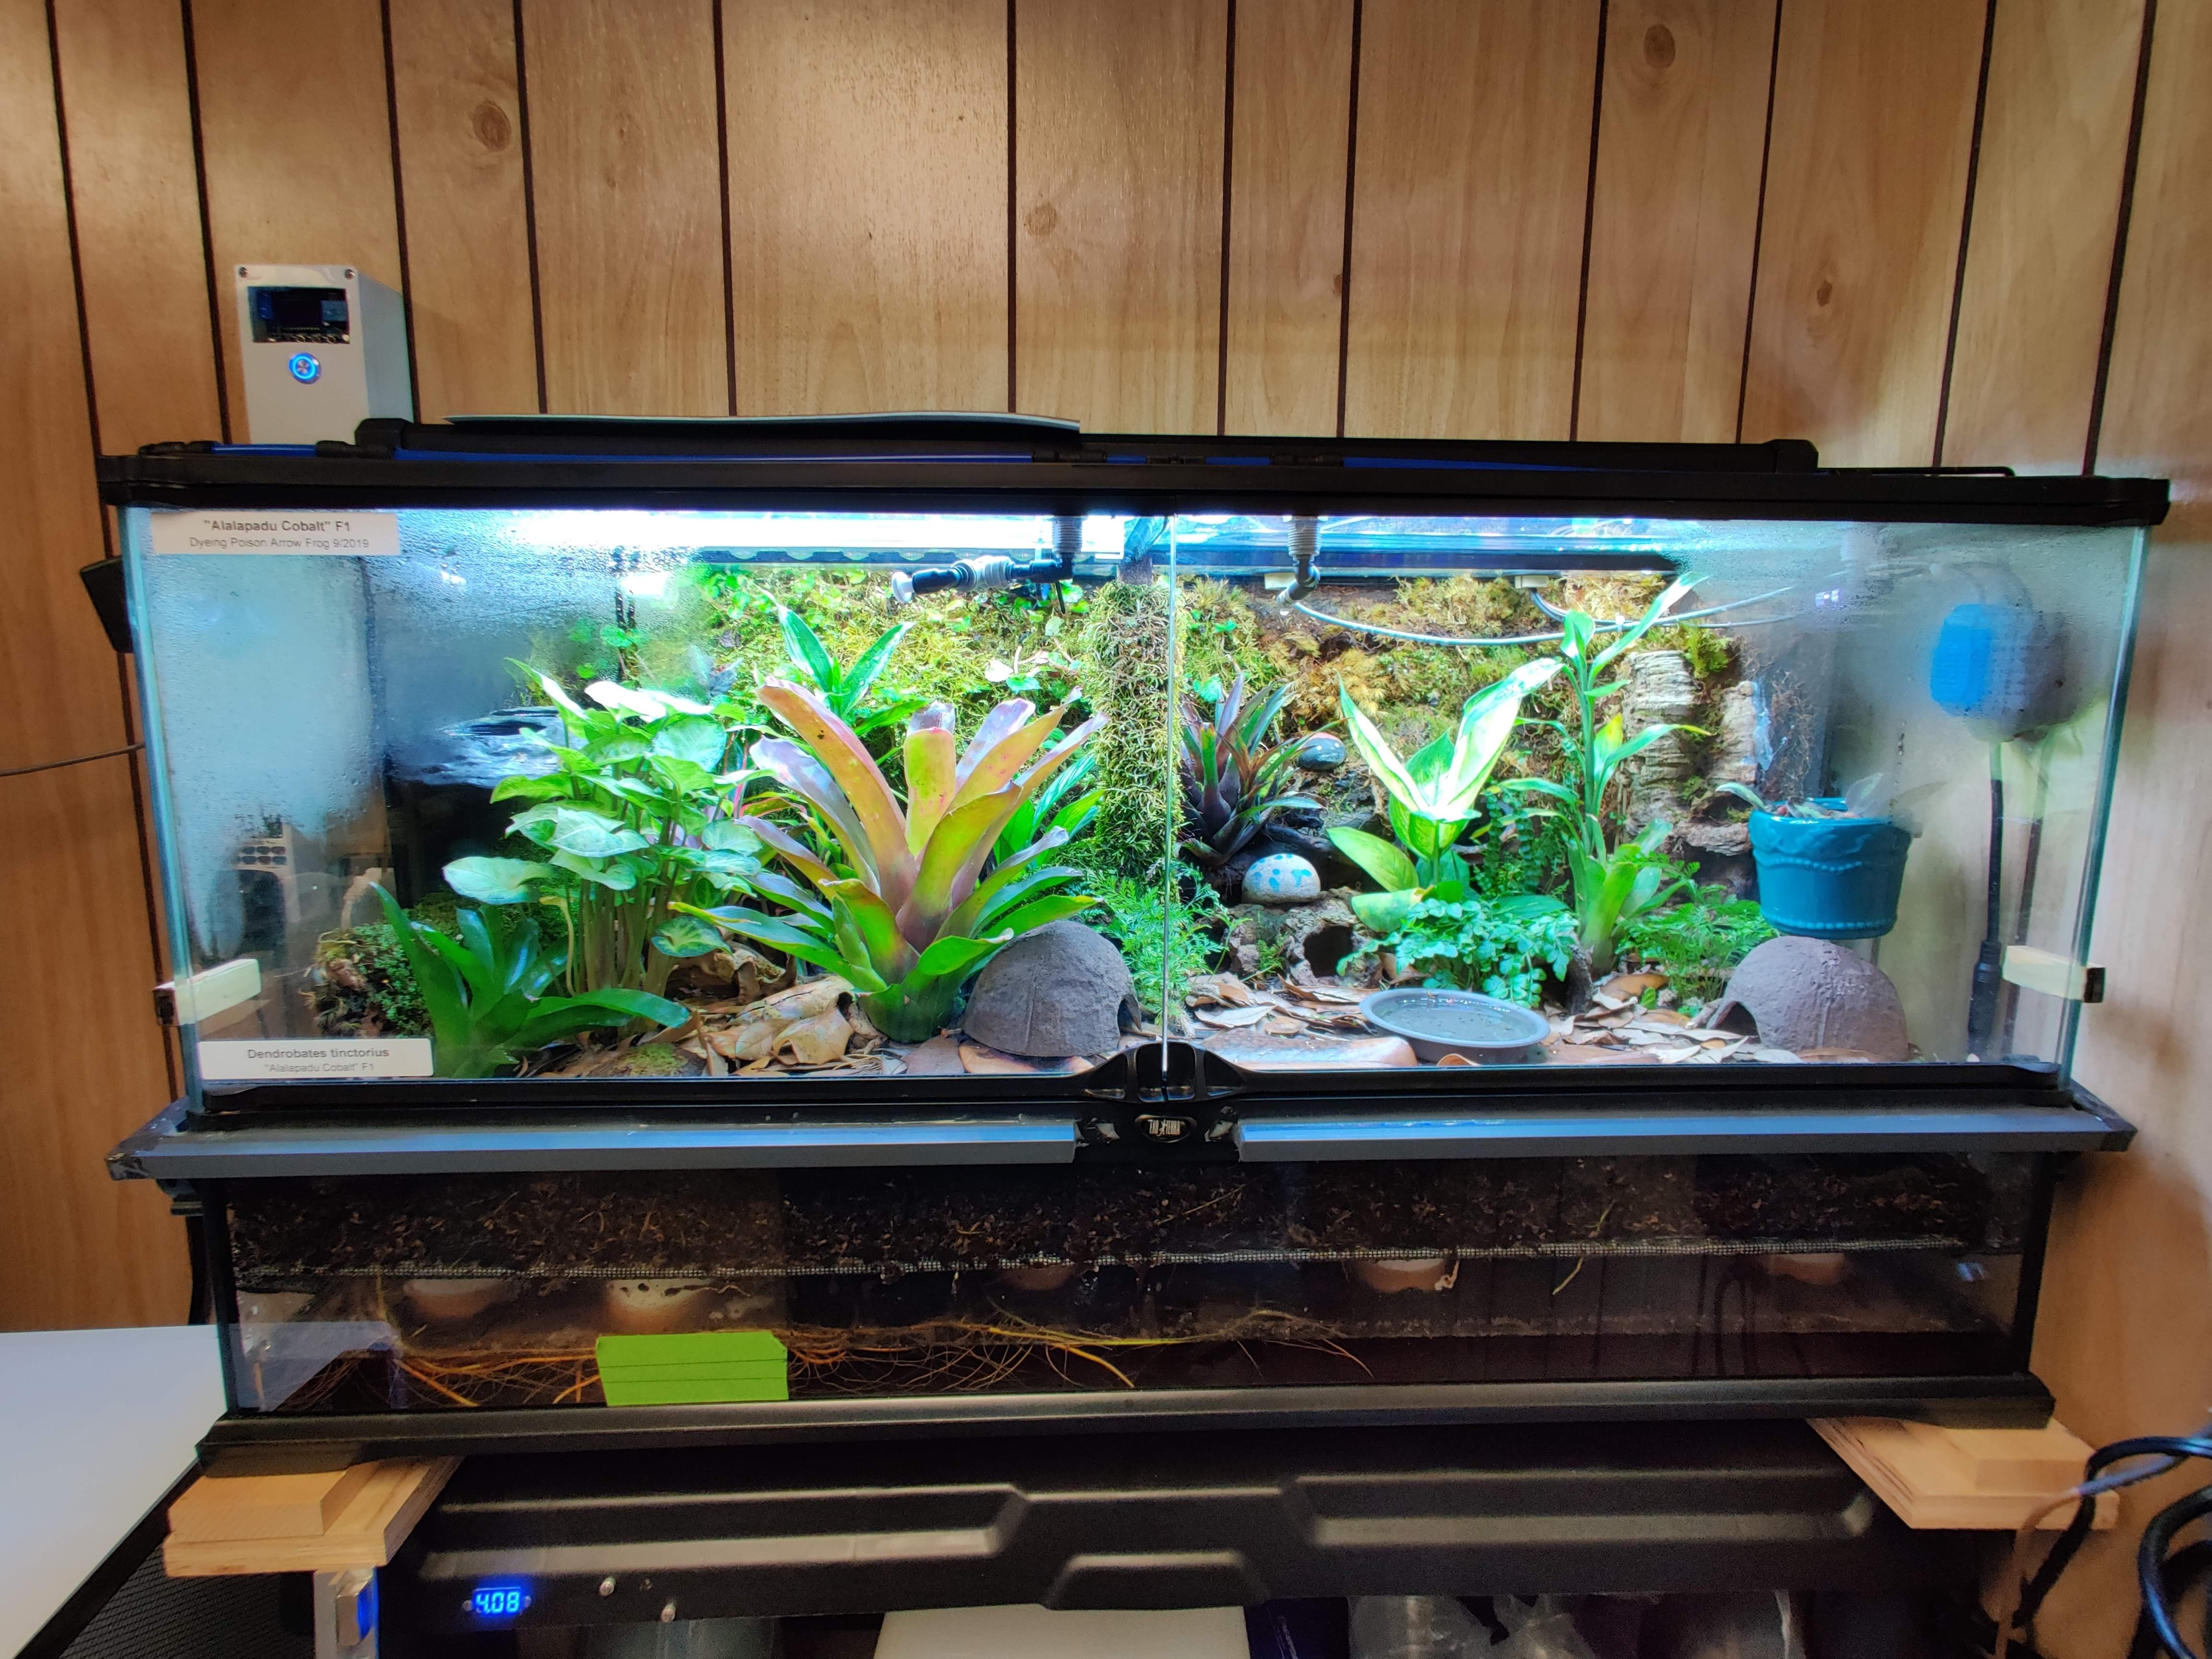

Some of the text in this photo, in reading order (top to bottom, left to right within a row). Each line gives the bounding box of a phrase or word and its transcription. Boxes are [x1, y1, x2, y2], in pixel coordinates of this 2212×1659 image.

[204, 520, 350, 533] "Alalapadu Cobalt" F1
[230, 538, 266, 547] Poison
[270, 538, 301, 548] Arrow
[306, 538, 329, 550] Frog
[333, 539, 369, 548] 9/2019
[247, 1048, 390, 1058] Dendrobates tinctorius
[265, 1064, 320, 1073] "Alalapadu
[323, 1063, 359, 1072] Cobalt"
